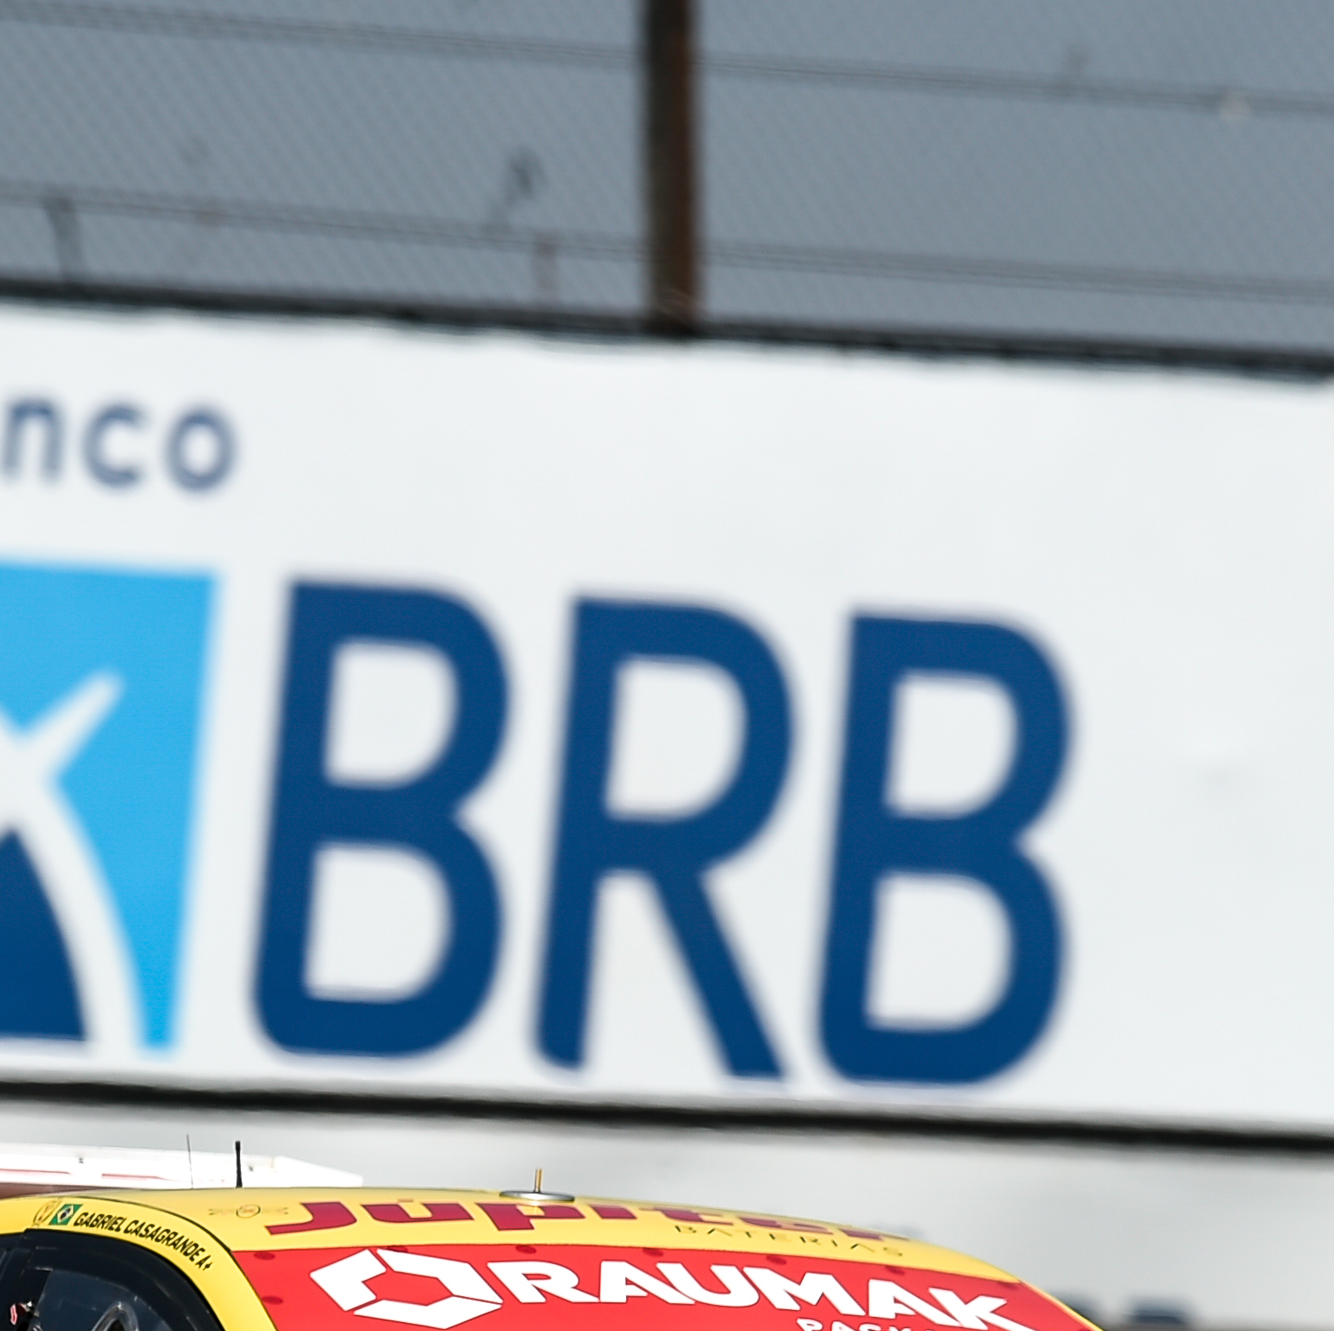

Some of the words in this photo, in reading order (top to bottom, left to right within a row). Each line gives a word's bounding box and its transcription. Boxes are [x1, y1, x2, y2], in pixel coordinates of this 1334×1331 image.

[255, 578, 1074, 1088] BRB
[73, 1211, 123, 1232] GABRIEL
[123, 1219, 207, 1264] CASAGRANDE
